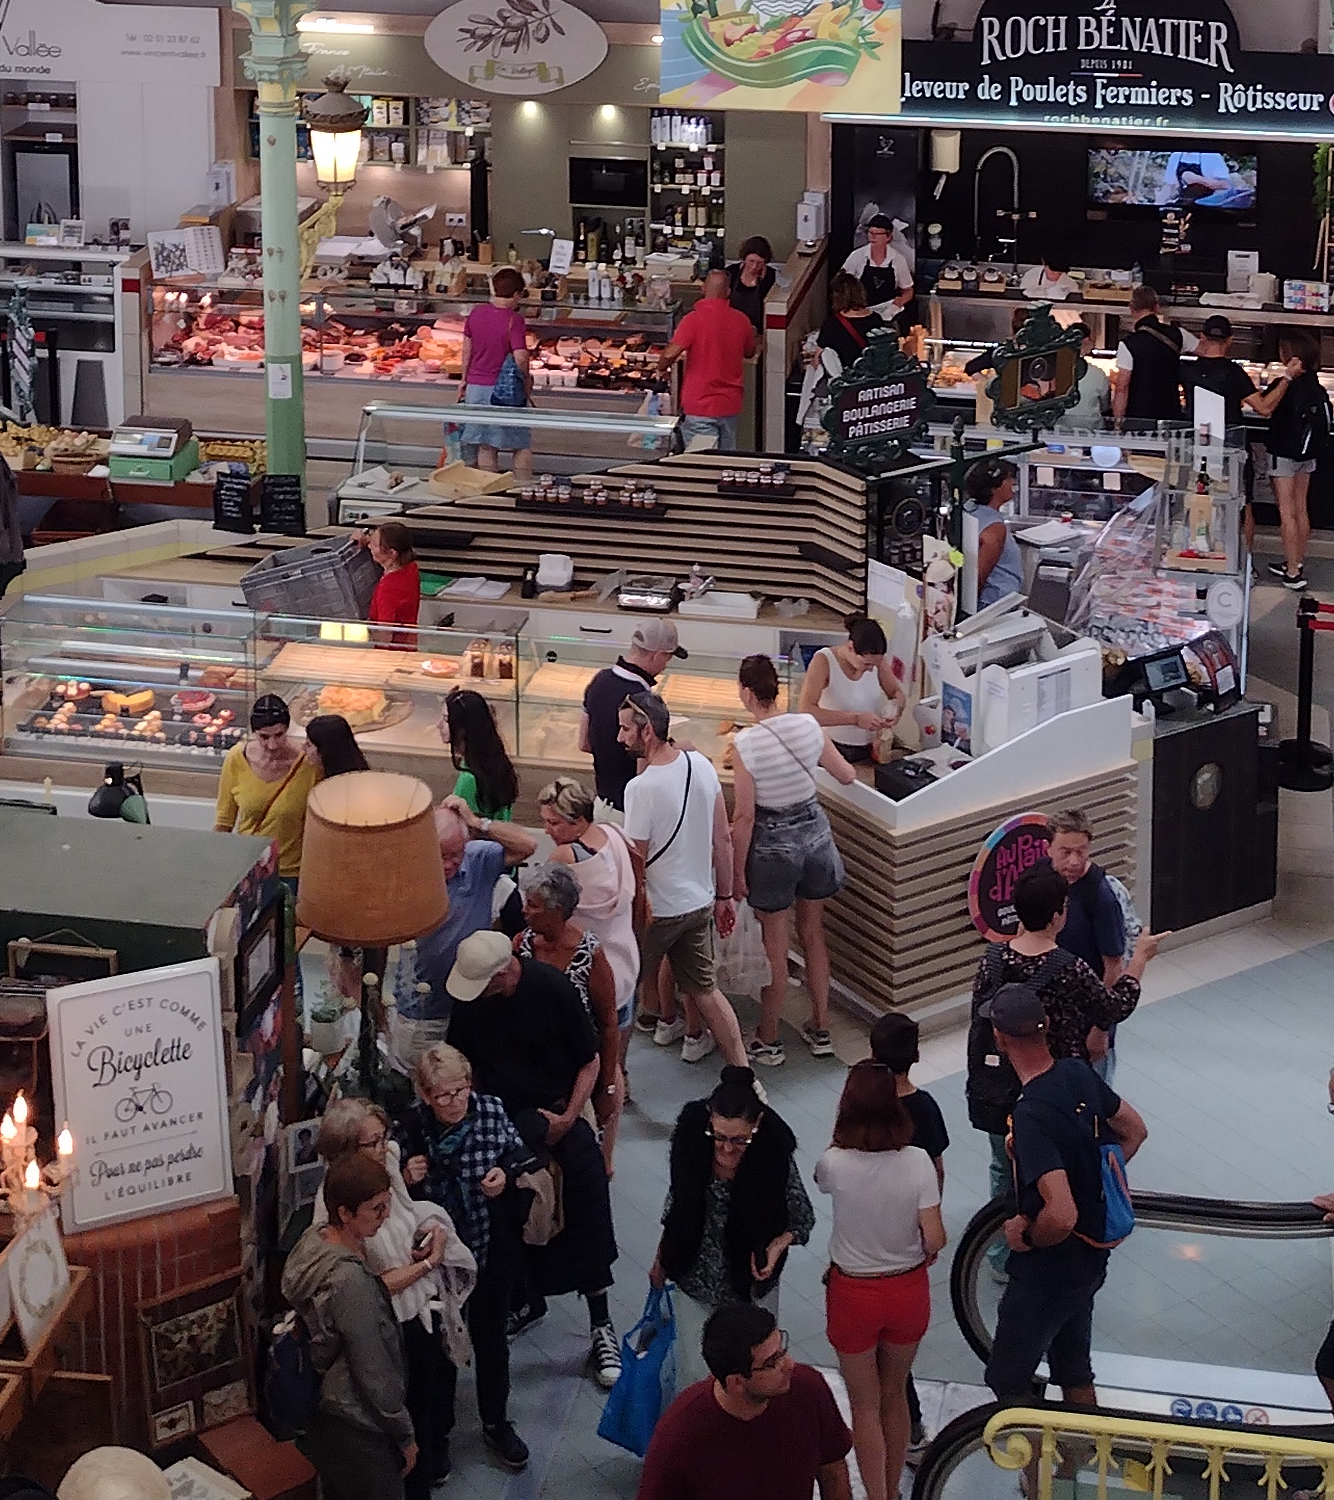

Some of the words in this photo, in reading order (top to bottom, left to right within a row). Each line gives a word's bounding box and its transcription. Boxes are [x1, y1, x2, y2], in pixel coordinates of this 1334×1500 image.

[1, 29, 62, 58] Vallée
[981, 16, 1068, 65] ROCH
[1077, 10, 1234, 72] BÉNATIER
[14, 64, 52, 75] monde
[1080, 59, 1108, 69] DEPUIS
[1111, 60, 1133, 70] 1981
[901, 73, 970, 102] leveur
[978, 74, 1002, 100] de
[1010, 76, 1088, 106] Poulets
[1094, 79, 1194, 109] Fermiers
[1218, 83, 1324, 113] Rôtisseur
[858, 383, 905, 403] ARTISAN
[842, 397, 917, 422] BOULANGERIE
[848, 415, 911, 439] PÂTISSERIE
[71, 1038, 87, 1058] LA
[85, 1013, 108, 1036] VIE
[112, 997, 154, 1017] C'EST
[159, 998, 208, 1032] COMME
[124, 1023, 153, 1037] UNE
[86, 1036, 192, 1088] Bicyclette
[85, 1135, 97, 1145] IL
[103, 1125, 136, 1141] FAUT
[142, 1111, 205, 1132] AVANCER
[89, 1159, 126, 1187] Pour
[128, 1160, 142, 1175] ne
[143, 1153, 166, 1177] pas
[166, 1142, 204, 1172] perdre
[104, 1172, 193, 1200] L'ÉQUILIBRE
